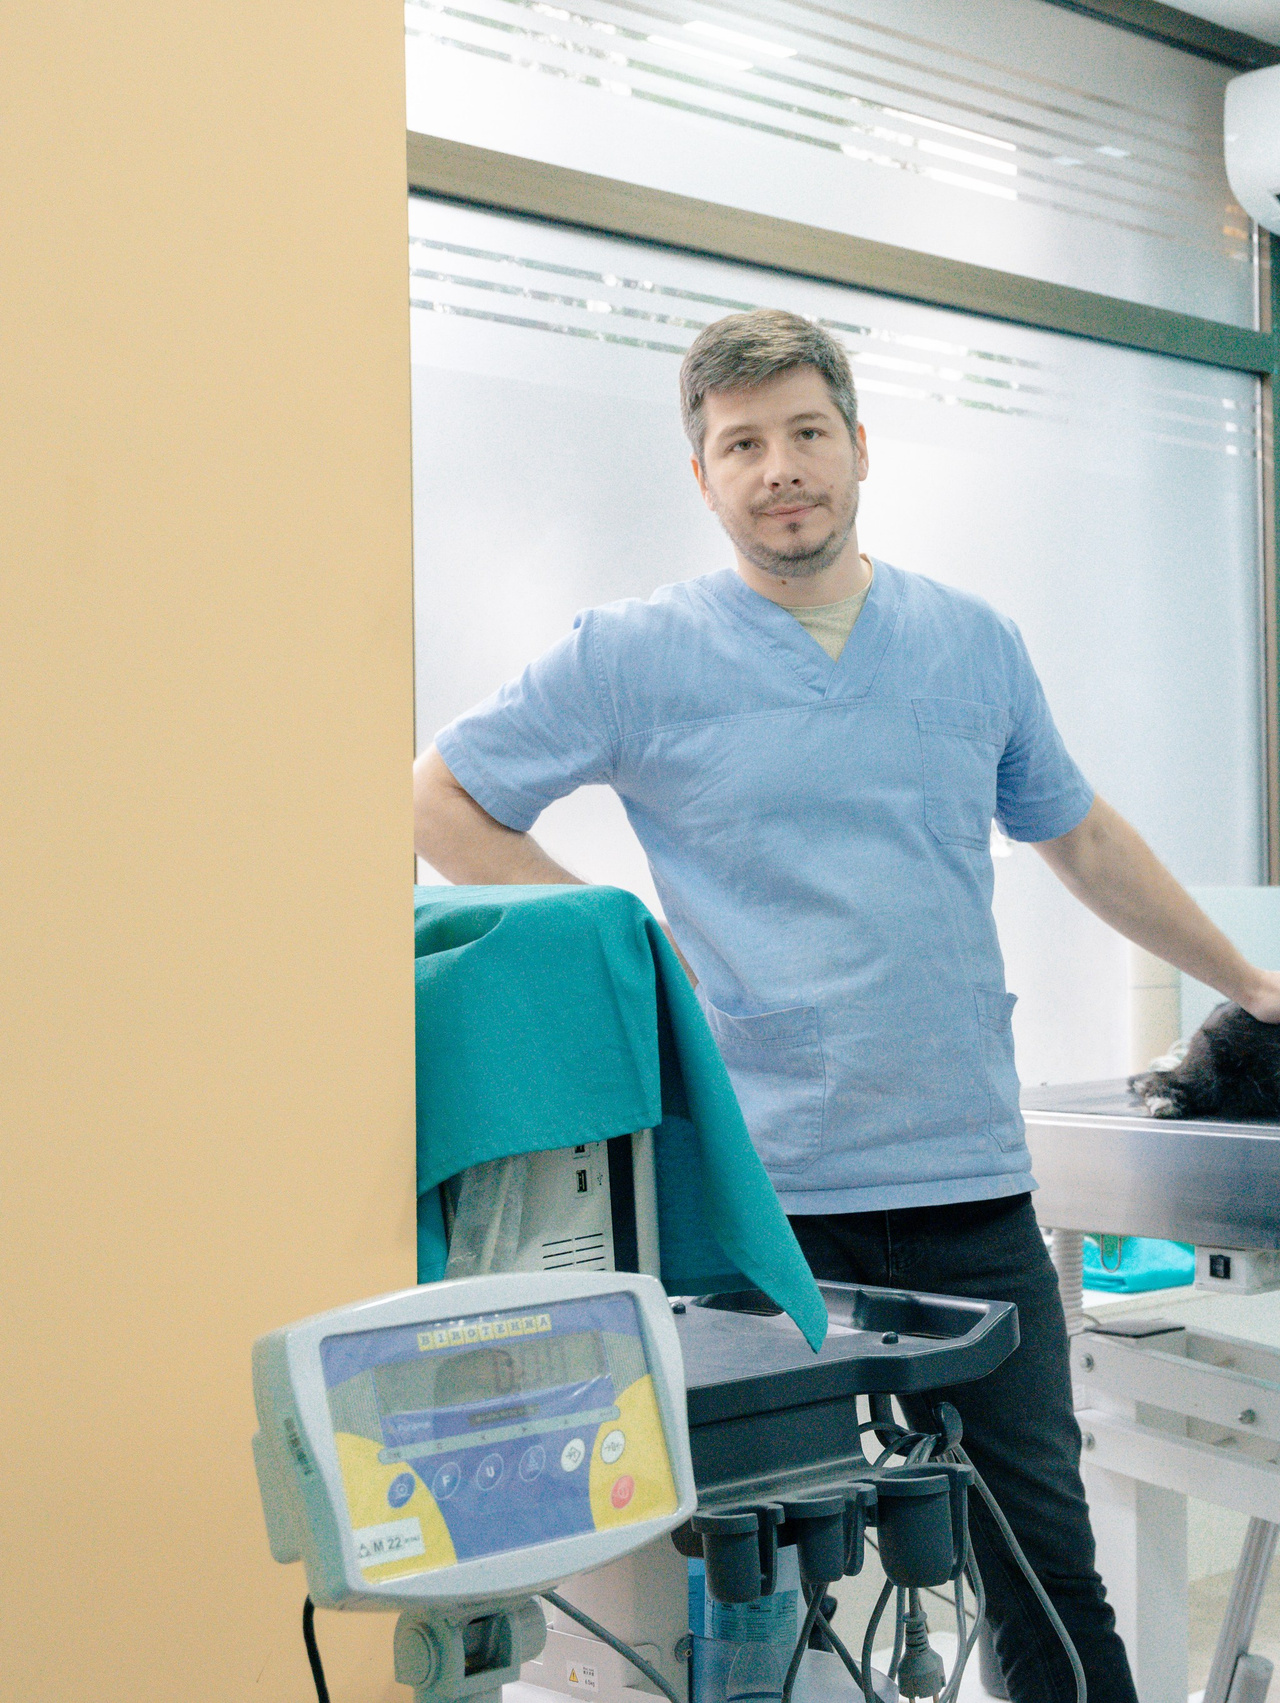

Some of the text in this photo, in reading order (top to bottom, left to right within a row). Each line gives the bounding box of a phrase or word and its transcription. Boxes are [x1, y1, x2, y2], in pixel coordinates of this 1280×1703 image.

[486, 1465, 495, 1478] U
[442, 1475, 450, 1487] F
[387, 1535, 403, 1551] 22
